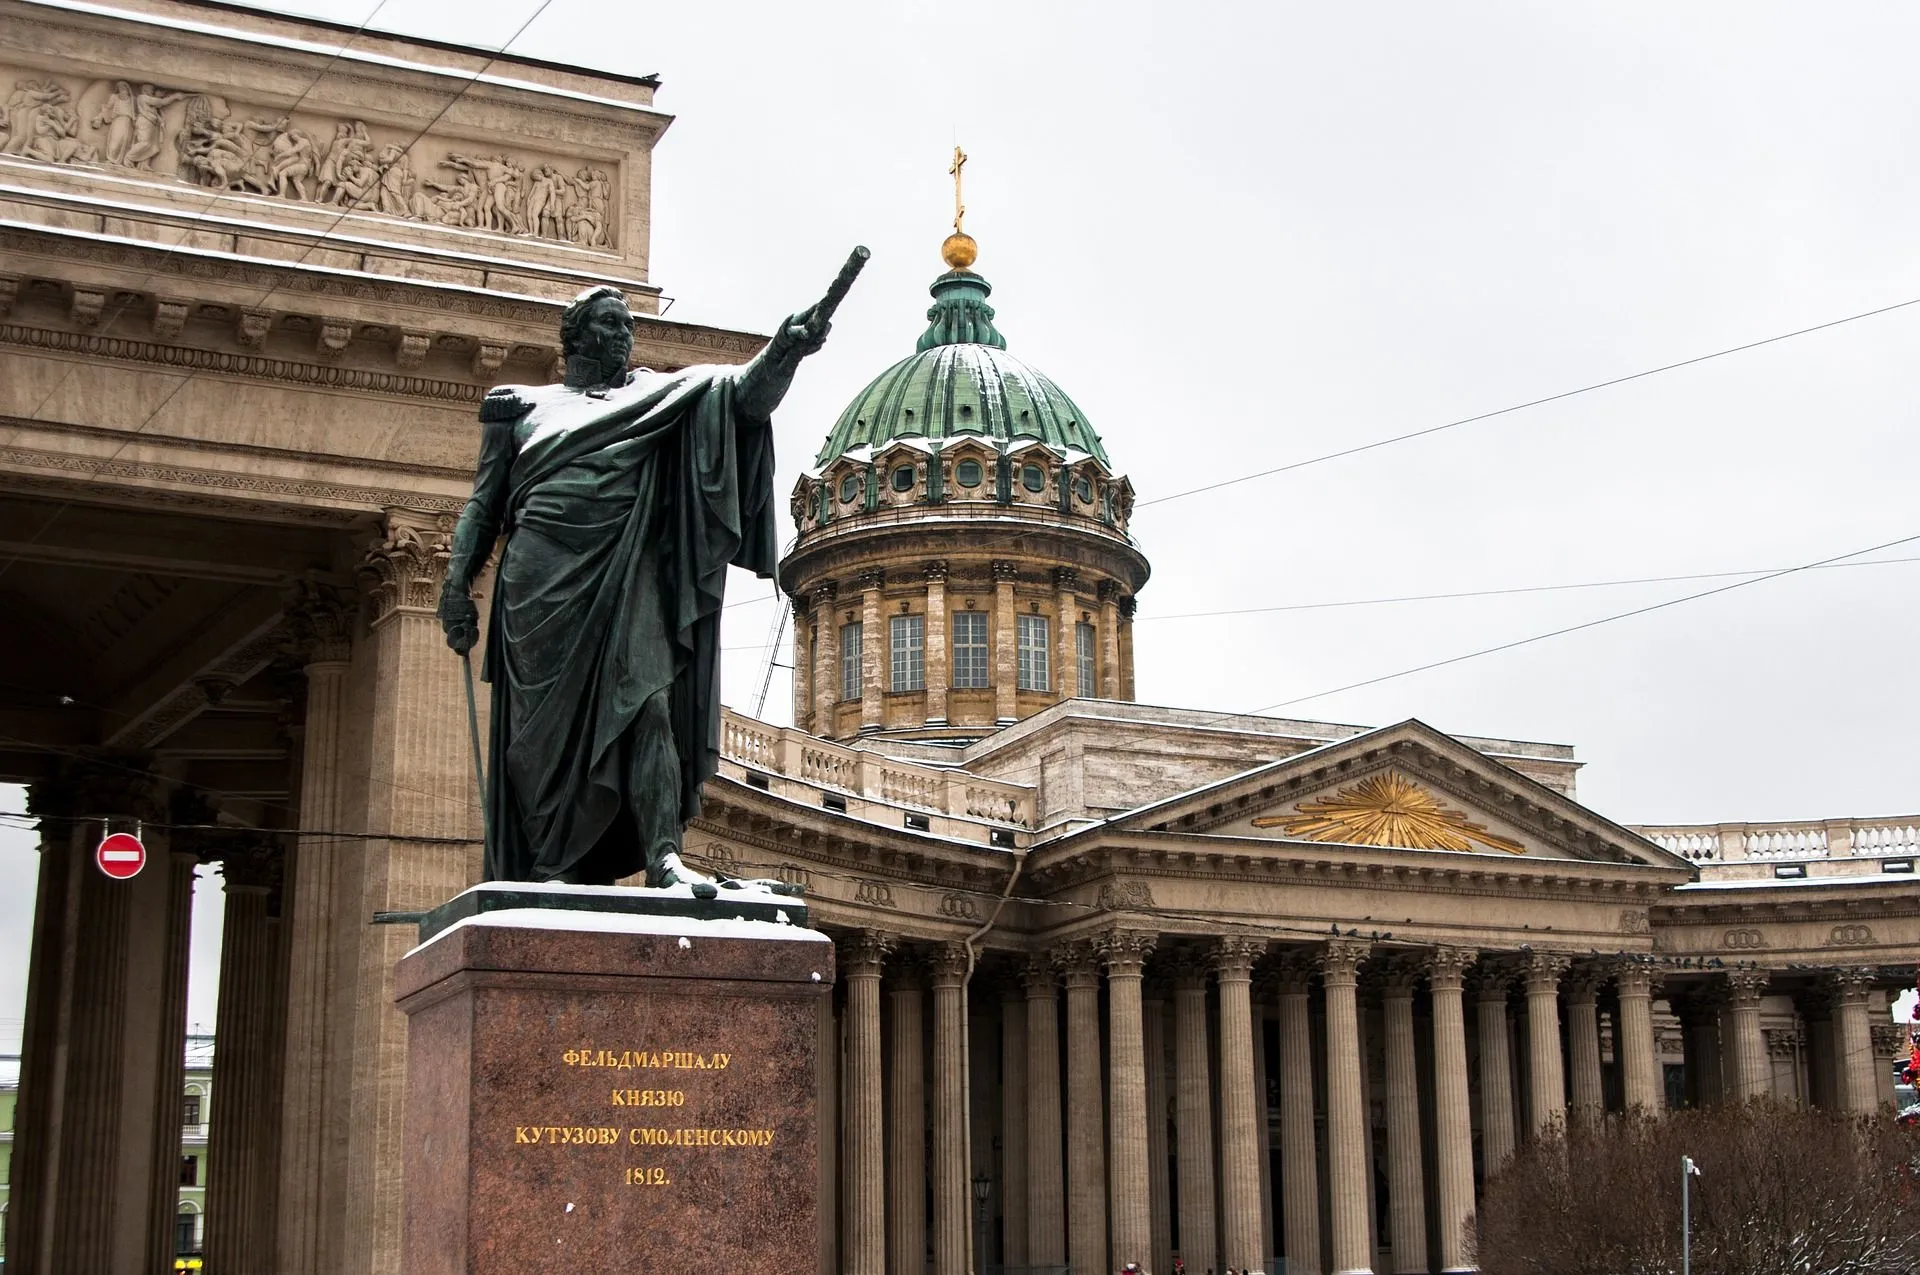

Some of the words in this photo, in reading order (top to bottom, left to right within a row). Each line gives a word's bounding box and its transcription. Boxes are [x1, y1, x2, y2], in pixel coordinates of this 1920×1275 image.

[562, 1049, 732, 1070] ФЕЛЬДМАРШАЛУ
[611, 1089, 685, 1107] КНЯЗЮ
[515, 1126, 621, 1145] КУТУЗОВУ
[629, 1128, 776, 1146] СМОЛЕНСКОМУ
[625, 1167, 671, 1185] 1812.
